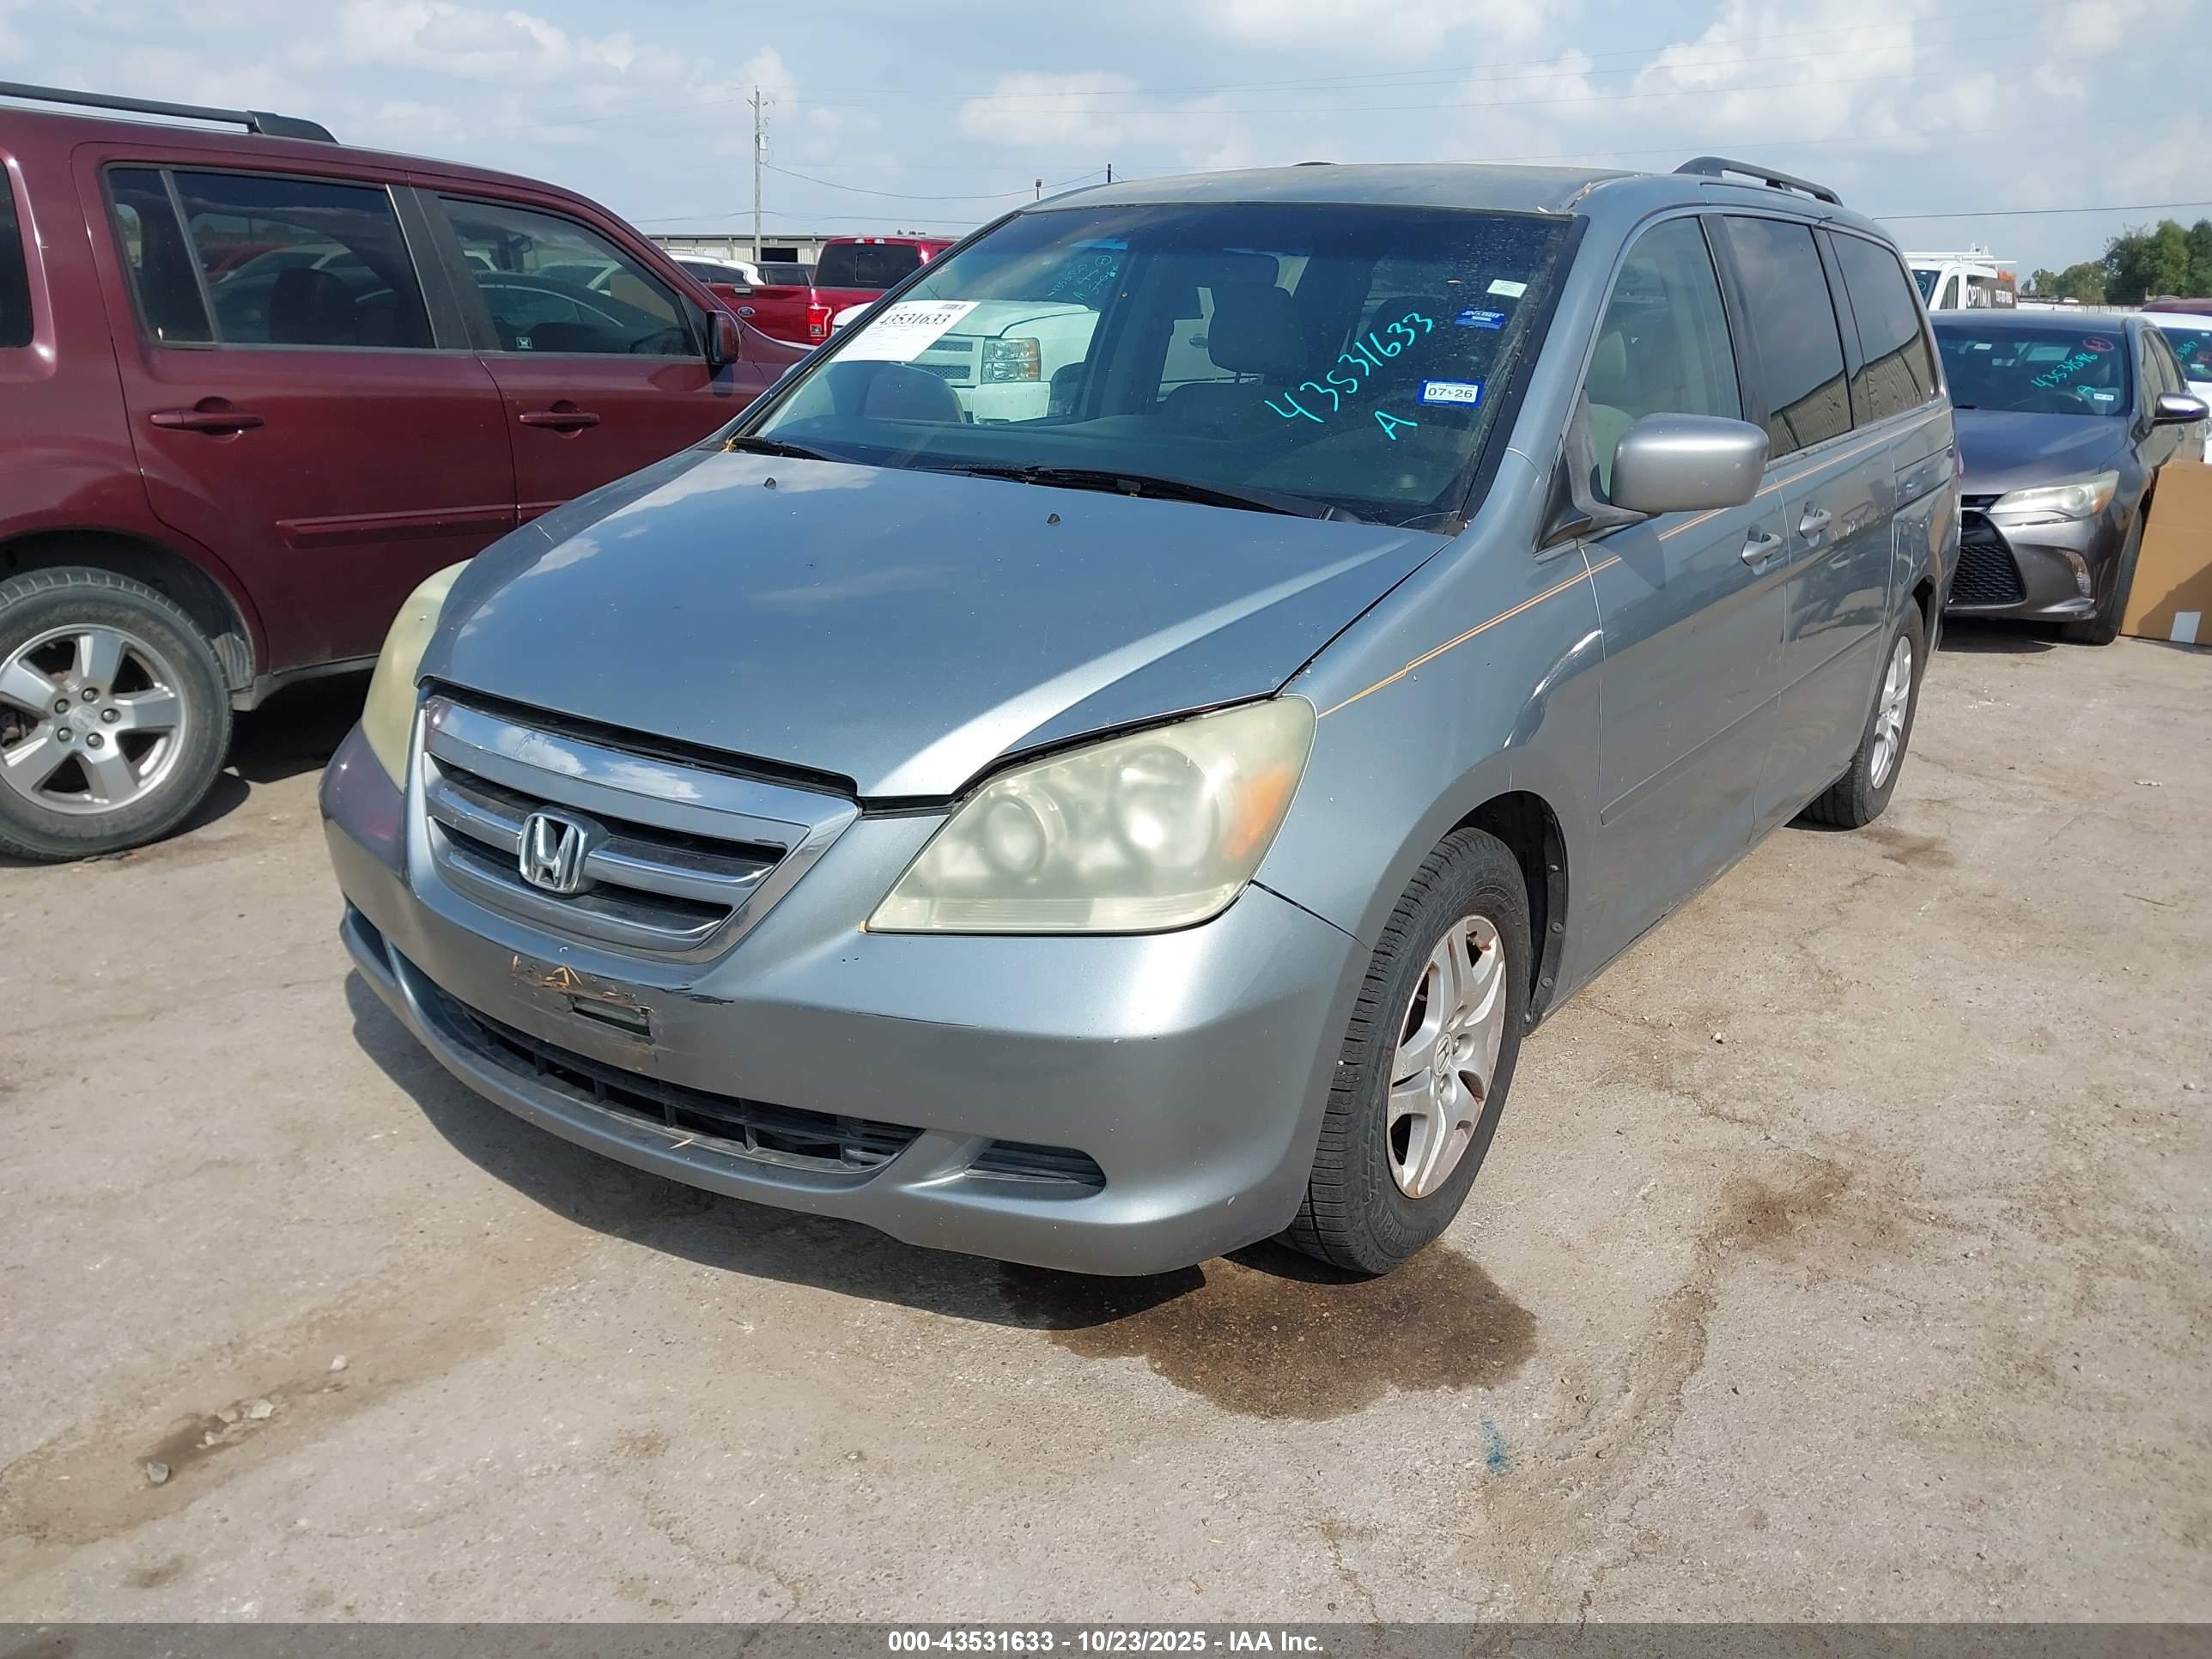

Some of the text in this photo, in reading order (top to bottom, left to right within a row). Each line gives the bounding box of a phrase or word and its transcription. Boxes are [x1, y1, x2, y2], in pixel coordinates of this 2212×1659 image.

[1966, 284, 1991, 308] OPTIMA
[879, 313, 951, 325] 43531633
[1265, 313, 1433, 423] 43531633
[2076, 385, 2096, 398] A
[1374, 410, 1418, 441] A
